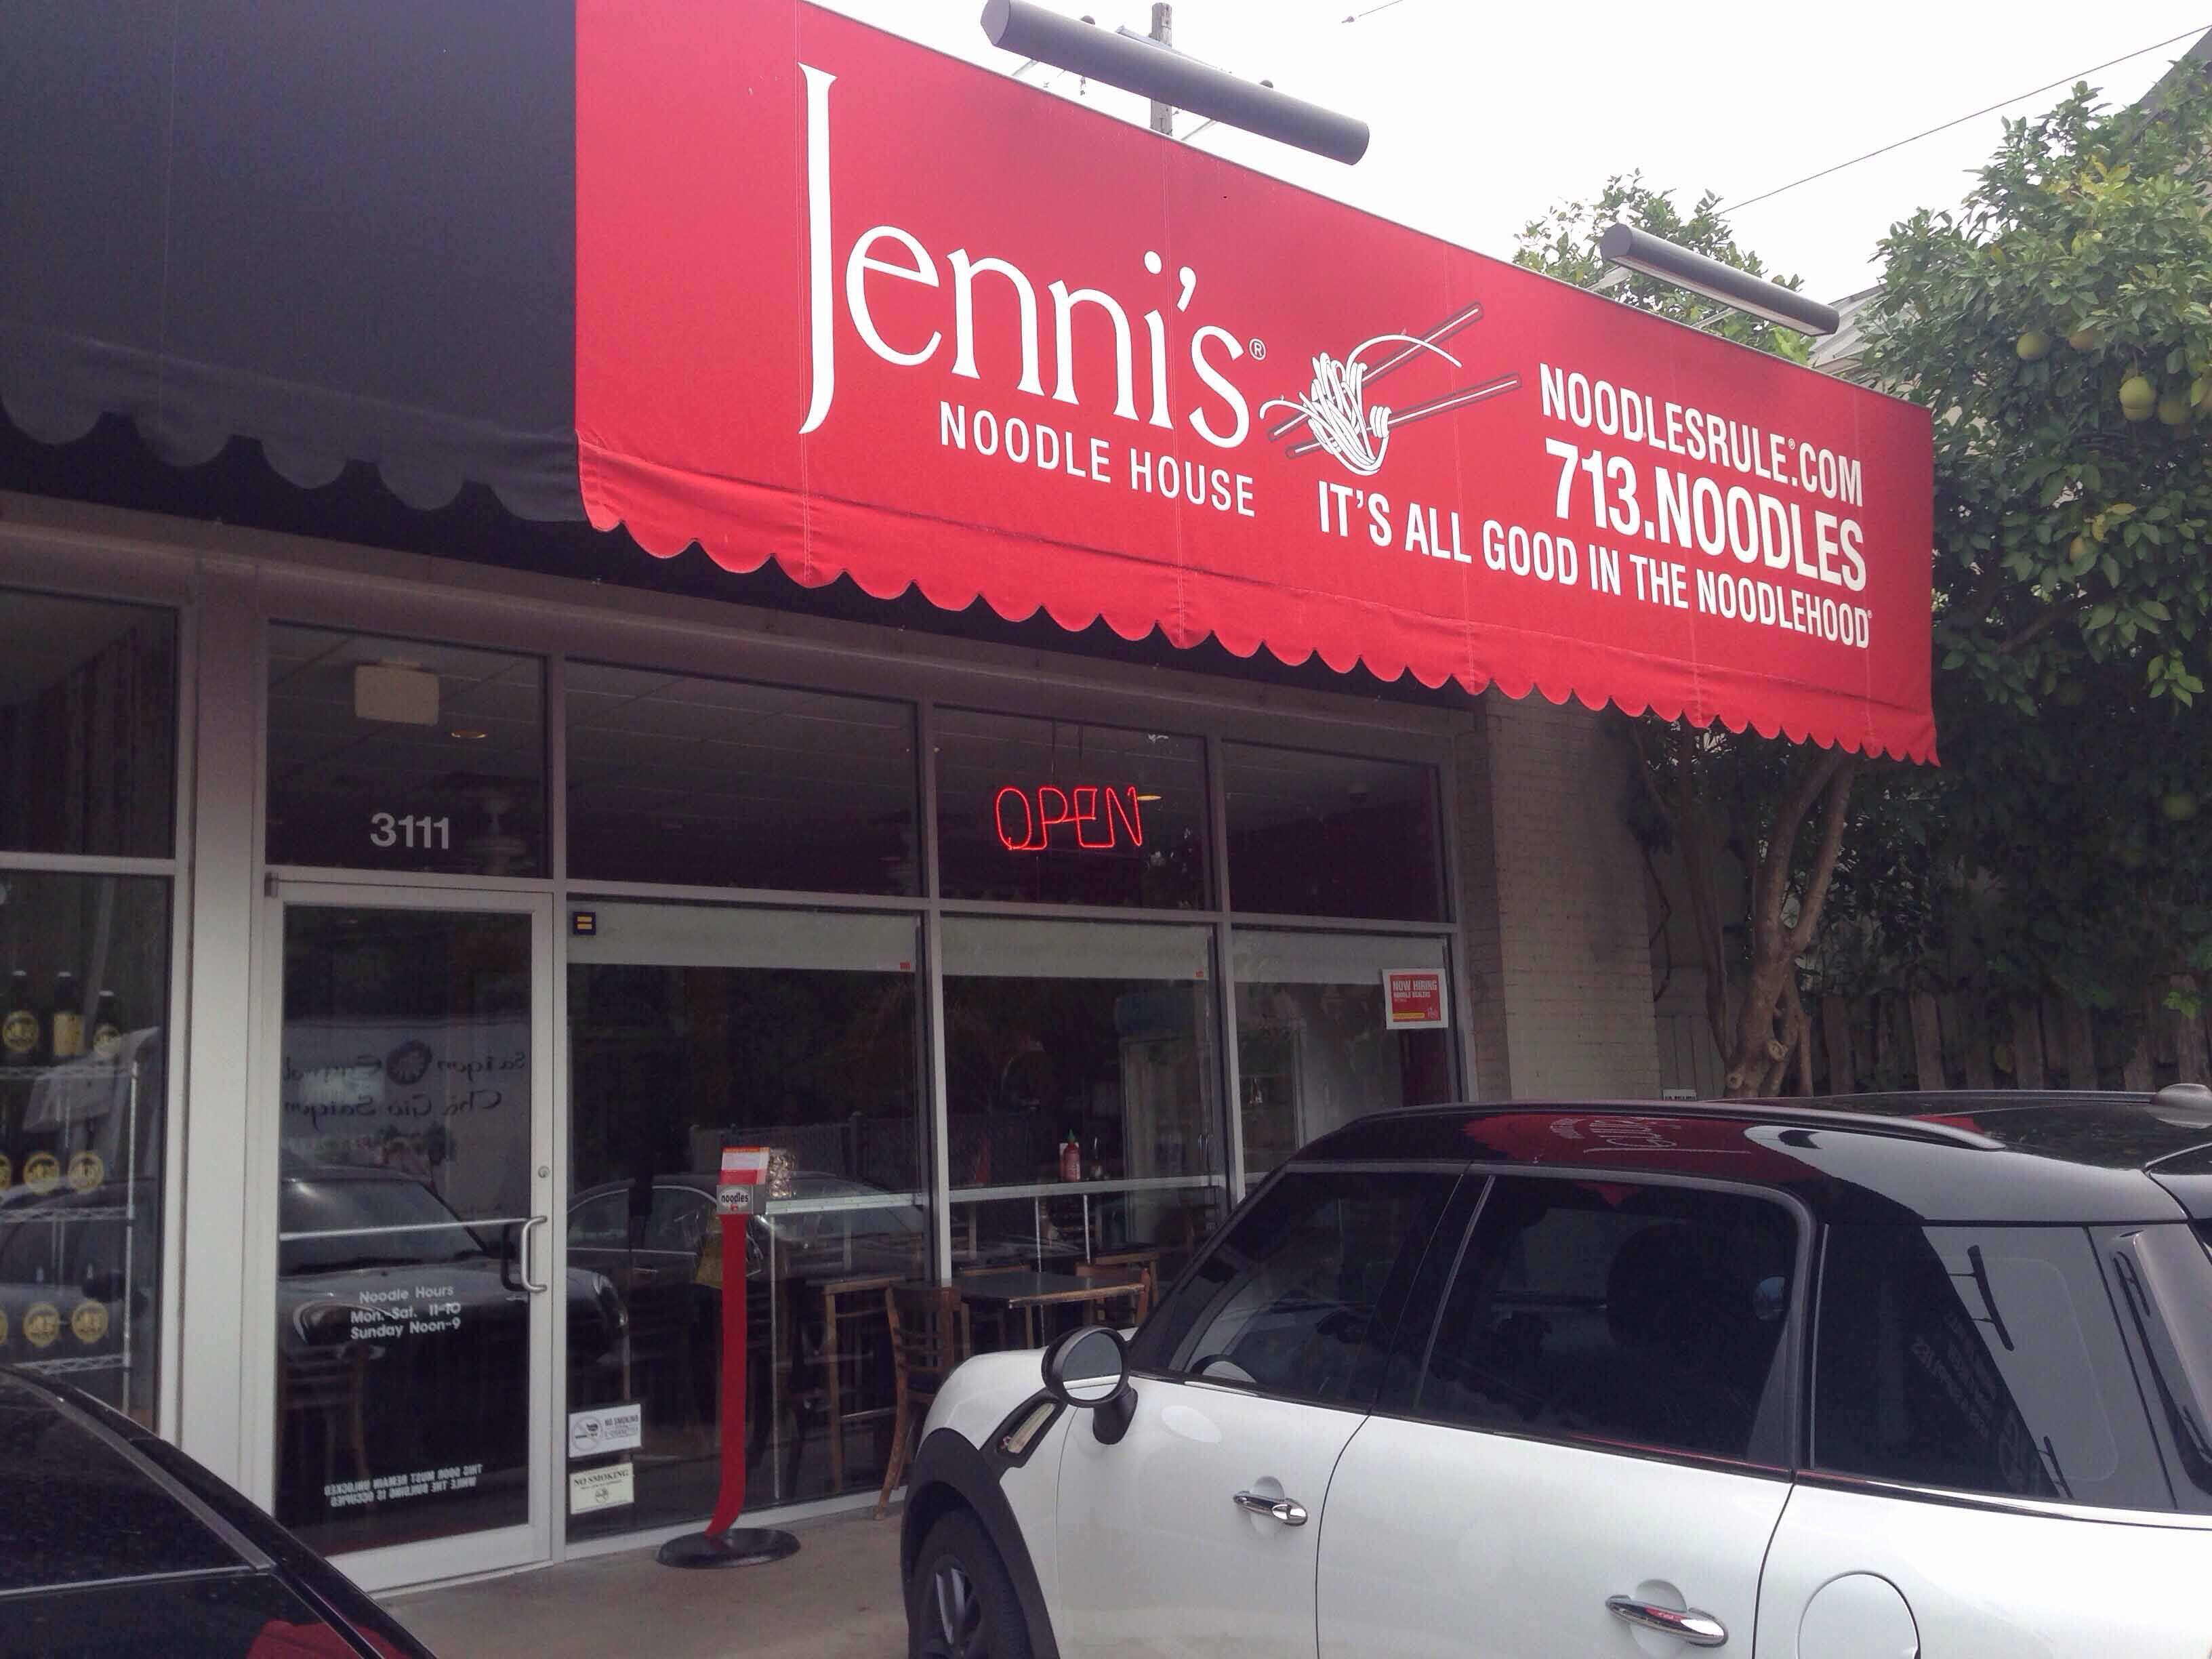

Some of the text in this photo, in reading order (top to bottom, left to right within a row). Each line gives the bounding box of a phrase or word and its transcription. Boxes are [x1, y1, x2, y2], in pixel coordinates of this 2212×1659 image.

[798, 62, 1250, 448] Jenni's
[941, 401, 1256, 517] NOODLE HOUSE
[1545, 437, 1866, 592] 713.NOODLES
[1317, 480, 1870, 649] IT'S ALL GOOD IN THE NOODLEHOOD
[370, 812, 449, 849] 3111
[995, 785, 1143, 851] OPEN
[1393, 980, 1437, 991] NOW HIRING
[721, 1193, 749, 1203] noodles
[359, 1286, 454, 1303] Noodle Hours
[429, 1302, 462, 1317] 11-10
[350, 1317, 462, 1340] Sunday Noon-9
[588, 1469, 630, 1483] SMOKING
